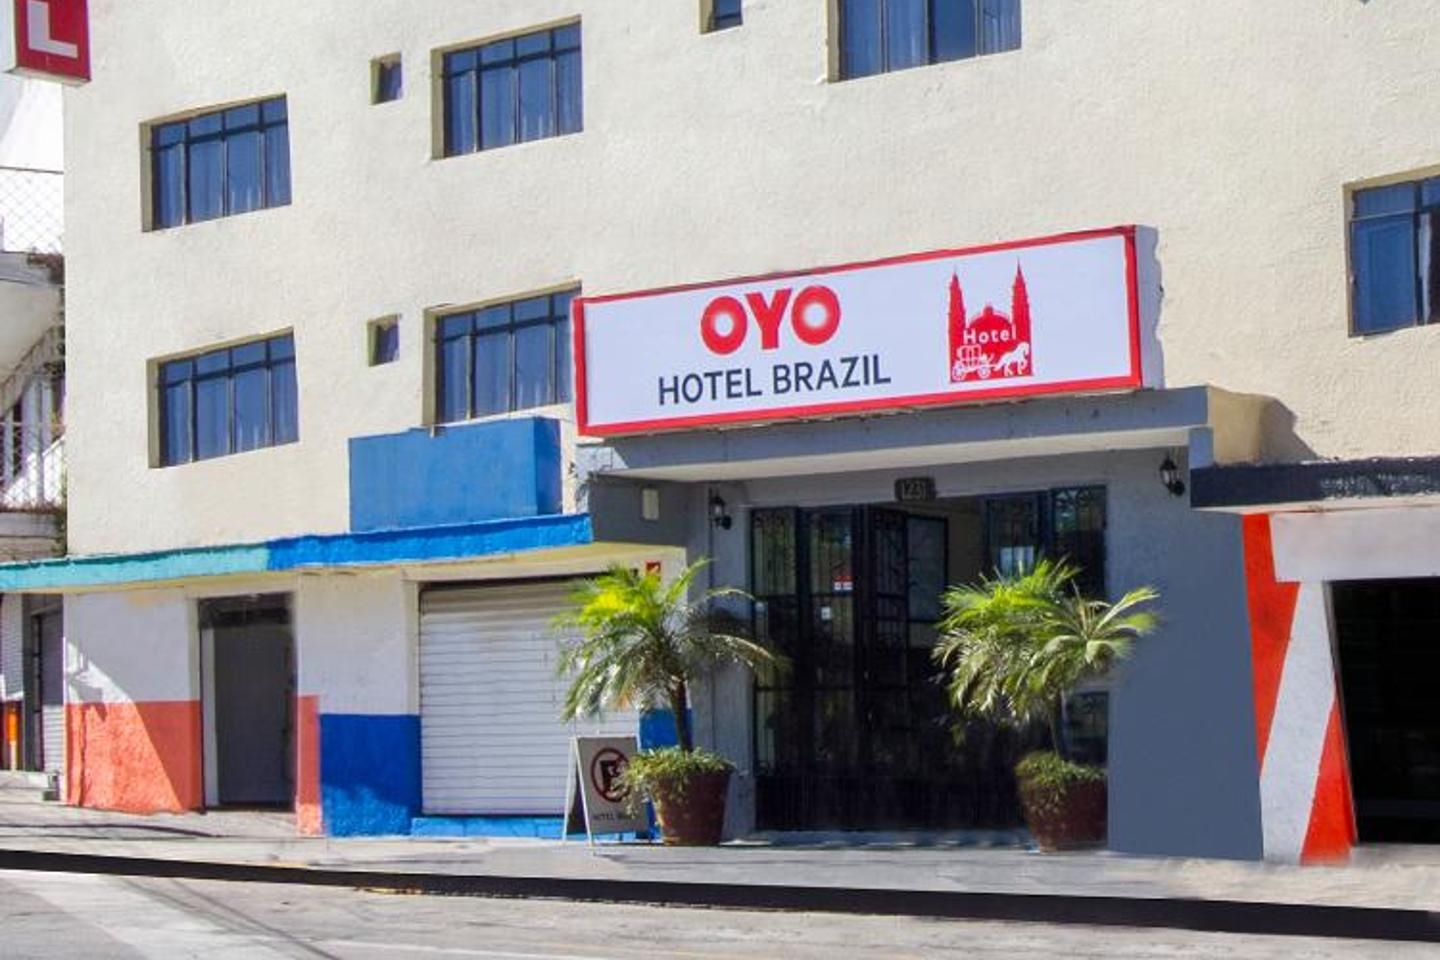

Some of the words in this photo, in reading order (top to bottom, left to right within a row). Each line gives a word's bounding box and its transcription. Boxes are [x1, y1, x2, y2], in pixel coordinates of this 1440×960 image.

[700, 285, 841, 355] OYO
[963, 323, 1017, 344] Hotel
[658, 368, 762, 406] HOTEL
[772, 353, 891, 395] BRAZIL
